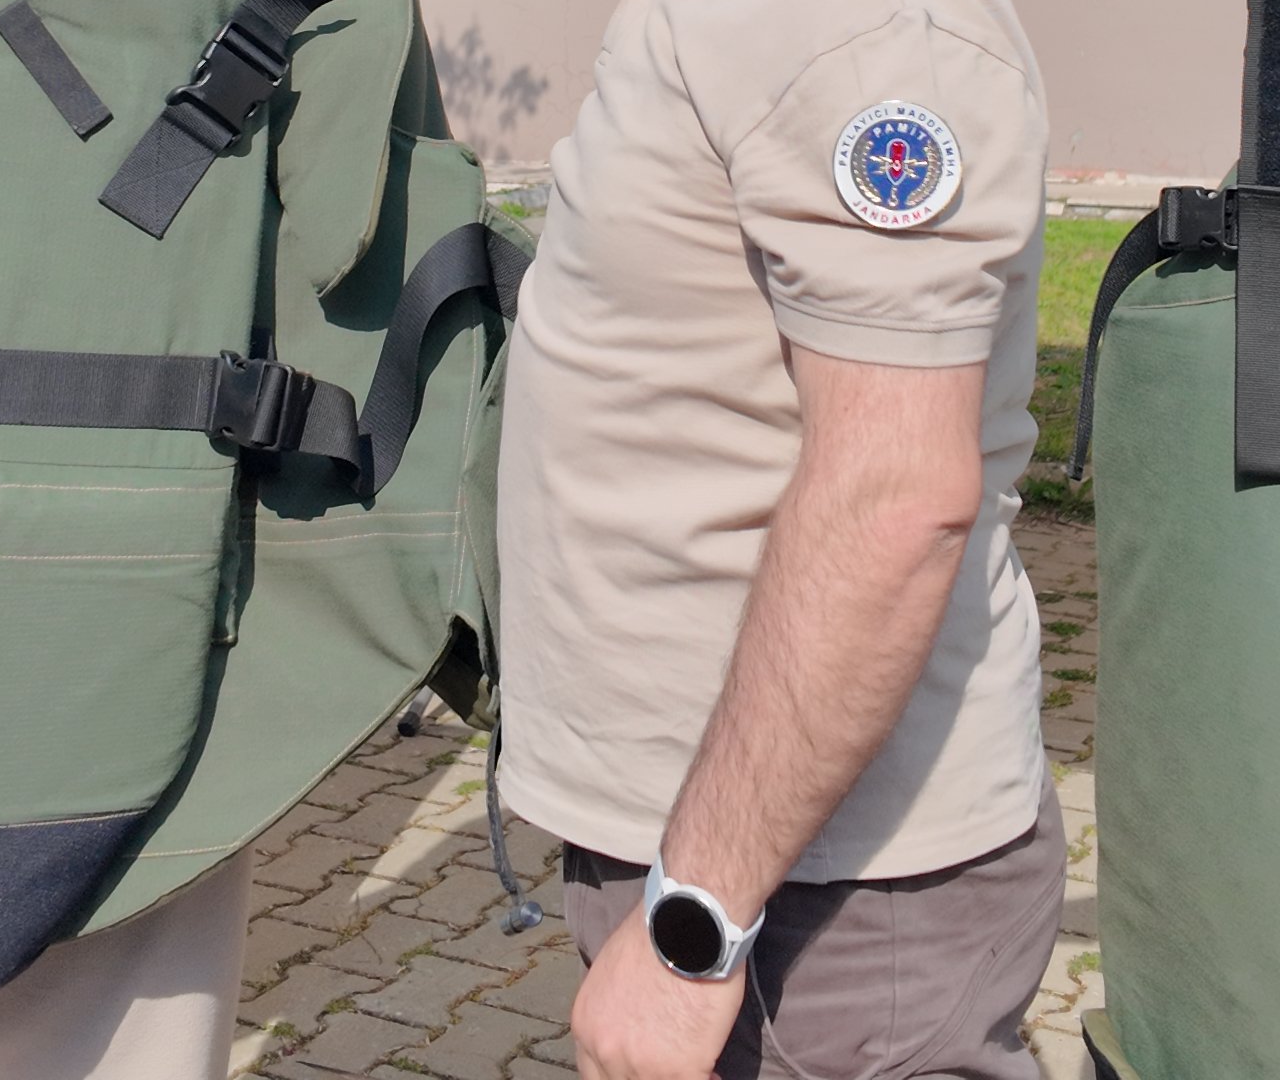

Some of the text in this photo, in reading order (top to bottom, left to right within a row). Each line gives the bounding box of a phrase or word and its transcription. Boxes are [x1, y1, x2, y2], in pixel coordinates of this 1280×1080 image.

[839, 108, 888, 166] PATLAYICI
[897, 107, 943, 136] MADDE
[853, 200, 933, 224] JANDARMA
